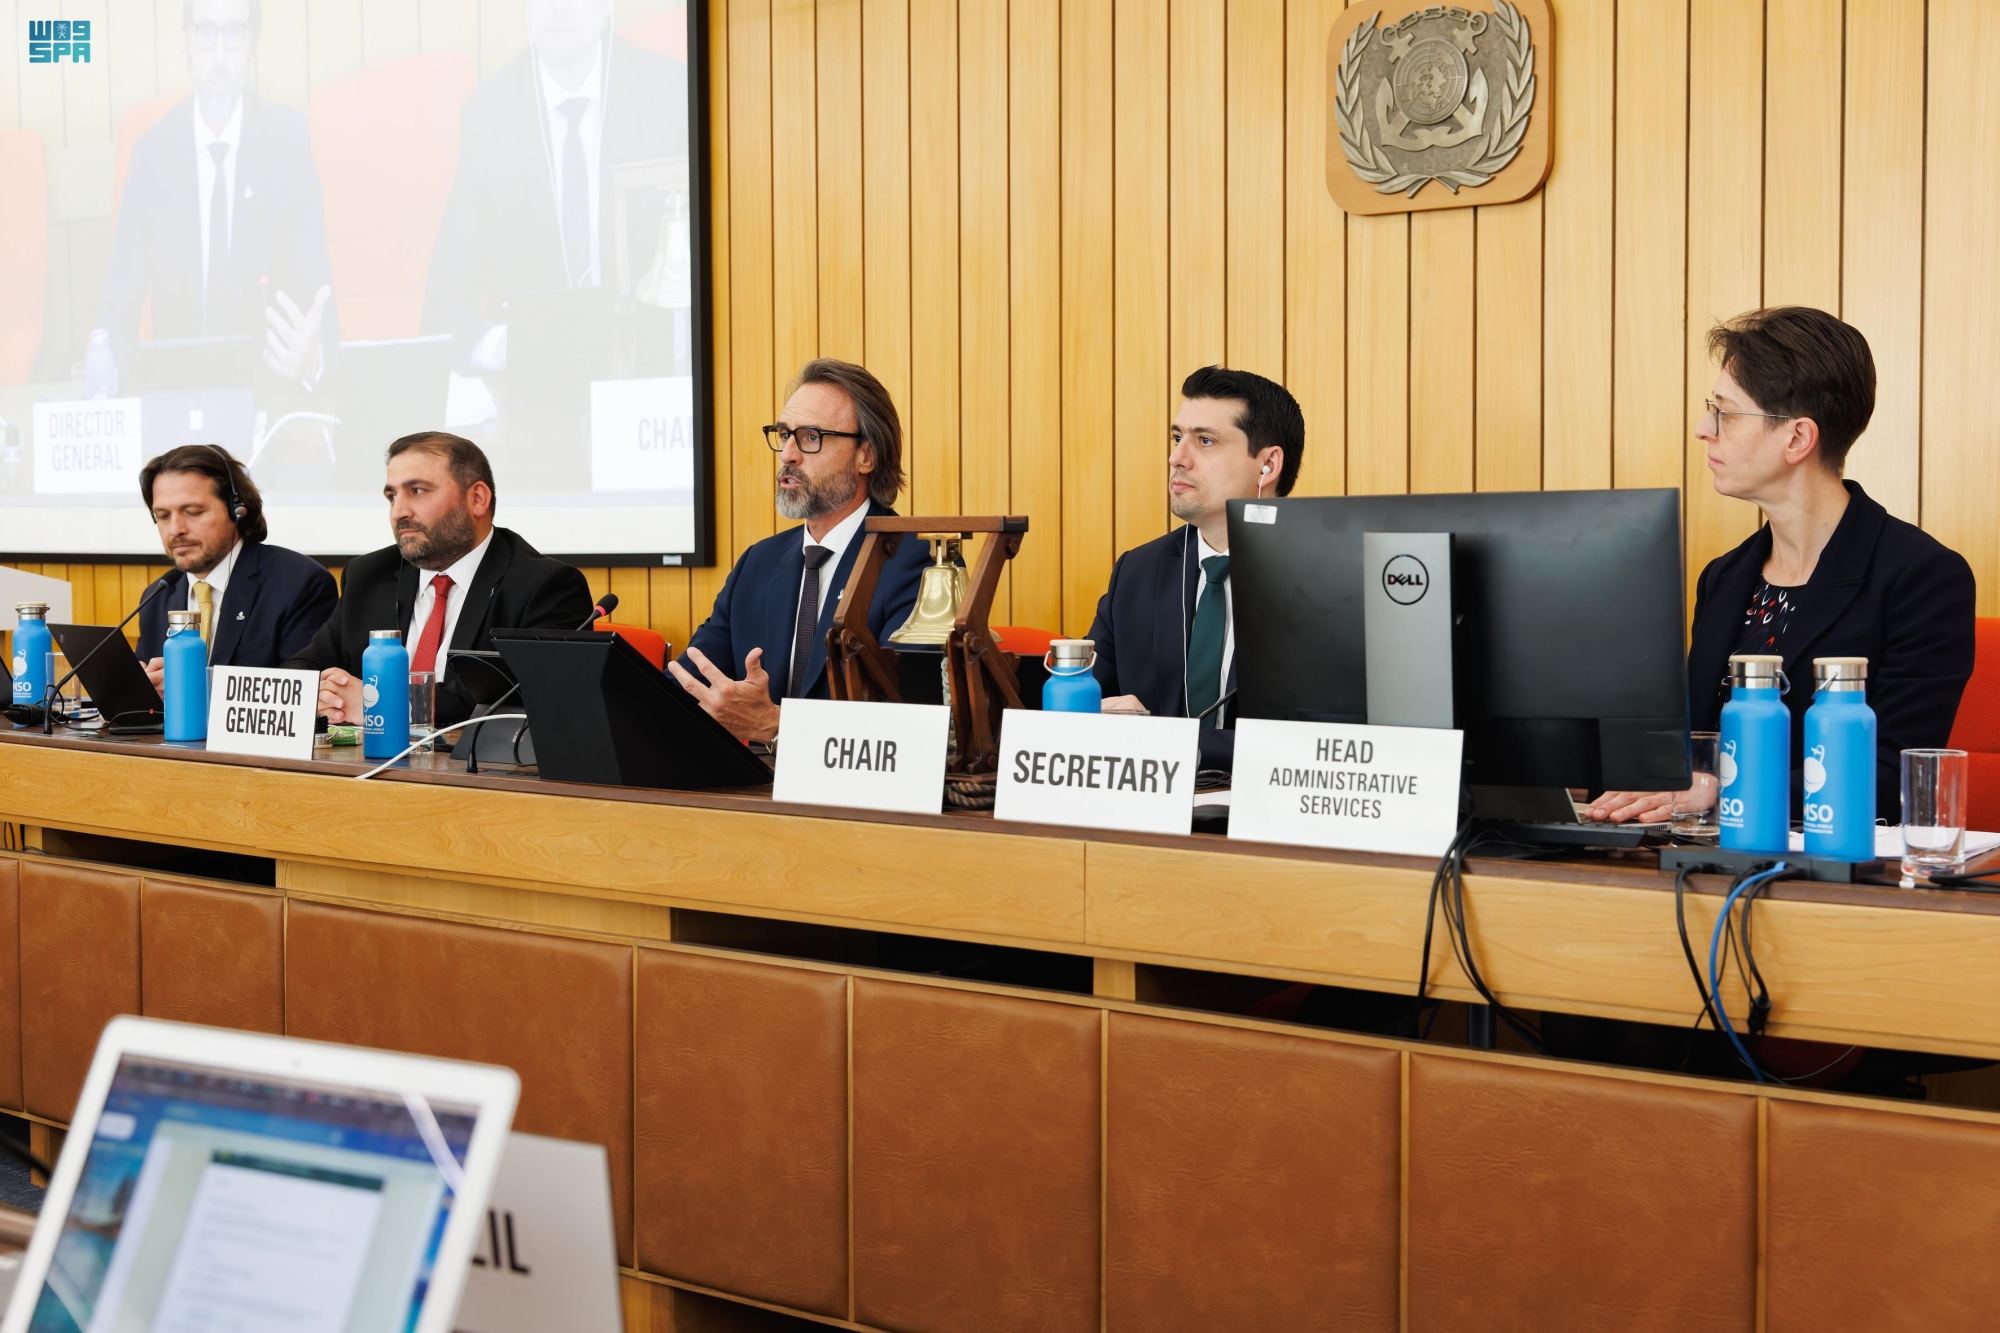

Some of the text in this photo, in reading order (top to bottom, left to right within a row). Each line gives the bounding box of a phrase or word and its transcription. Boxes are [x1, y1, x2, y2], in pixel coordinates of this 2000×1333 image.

[49, 410, 124, 439] DIRECTOR
[52, 444, 123, 471] GENERAL
[1387, 573, 1424, 586] DELL
[226, 675, 302, 706] DIRECTOR
[226, 706, 296, 738] GENERAL
[824, 737, 897, 773] CHAIR
[1316, 738, 1374, 764] HEAD
[1013, 750, 1180, 794] SECRETARY
[1269, 767, 1418, 795] ADMINISTRATIVE
[1300, 795, 1382, 819] SERVICES
[472, 1209, 530, 1274] IL
